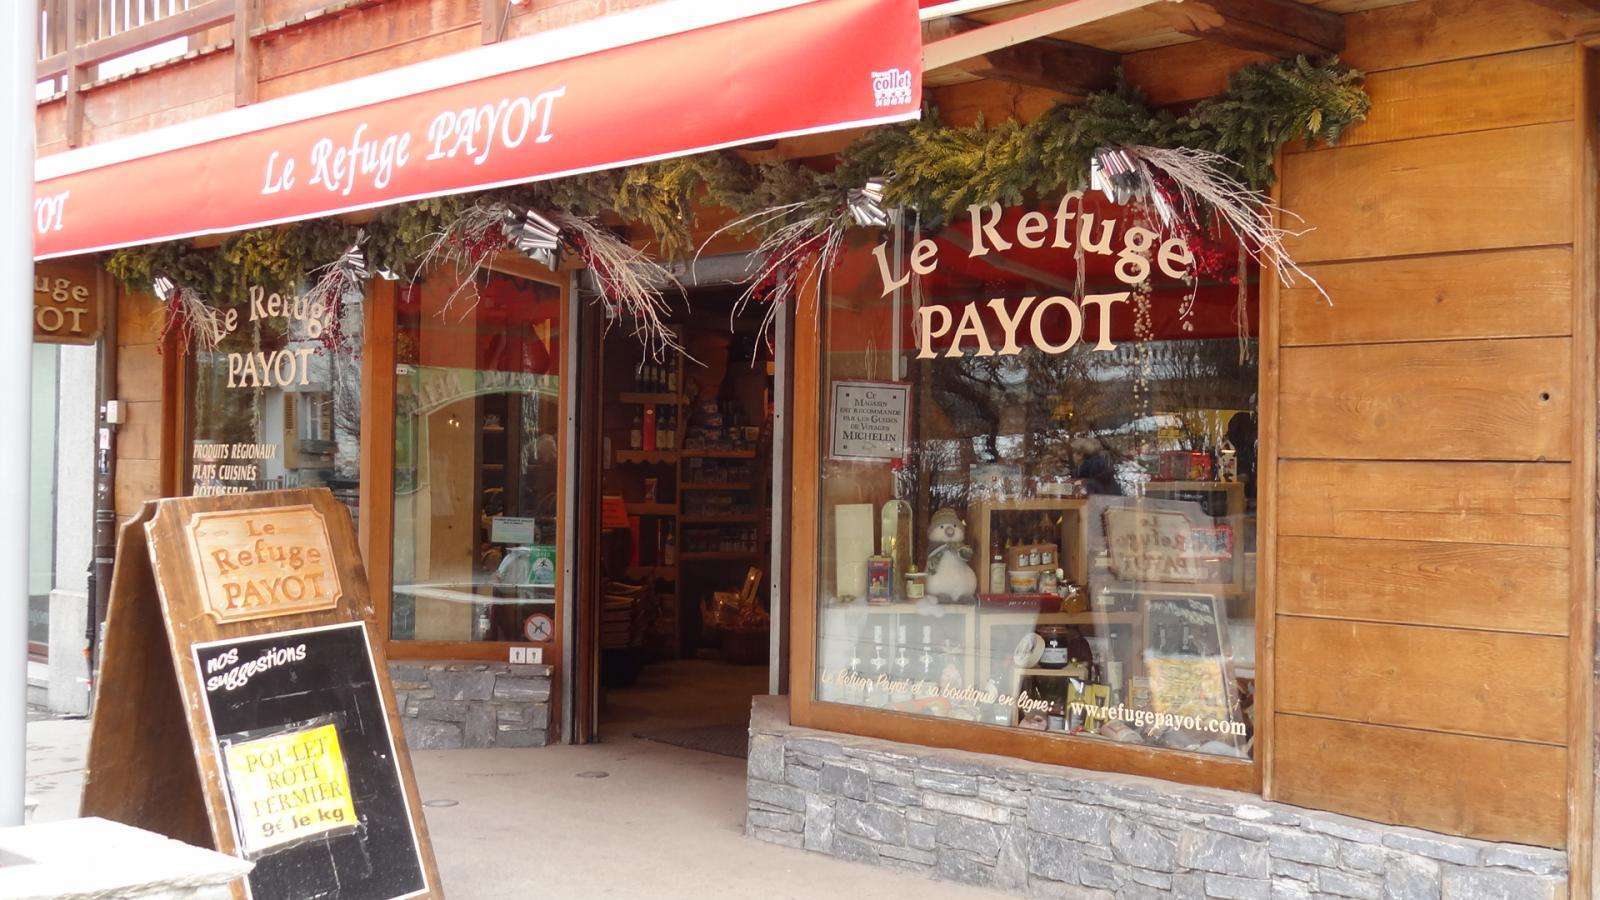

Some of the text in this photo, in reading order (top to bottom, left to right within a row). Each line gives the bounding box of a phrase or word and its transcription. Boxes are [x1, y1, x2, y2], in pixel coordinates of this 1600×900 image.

[261, 86, 567, 196] Le Refuge PAYOT
[34, 190, 70, 234] OT
[871, 189, 1195, 298] Le Refuge
[34, 304, 88, 332] OT
[915, 292, 1131, 360] PAYOT
[226, 348, 315, 388] PAYOT
[193, 441, 277, 460] PRODUITS RÉGIONAUX
[842, 430, 897, 442] MICHELIN
[192, 464, 257, 481] PLATS CUISINÉS
[246, 519, 275, 537] Le
[211, 538, 321, 576] Refuge
[222, 571, 325, 610] PAYOT
[206, 647, 239, 674] nos
[206, 643, 307, 692] suggestions
[998, 693, 1014, 706] en
[291, 814, 312, 830] le
[317, 807, 345, 823] kg
